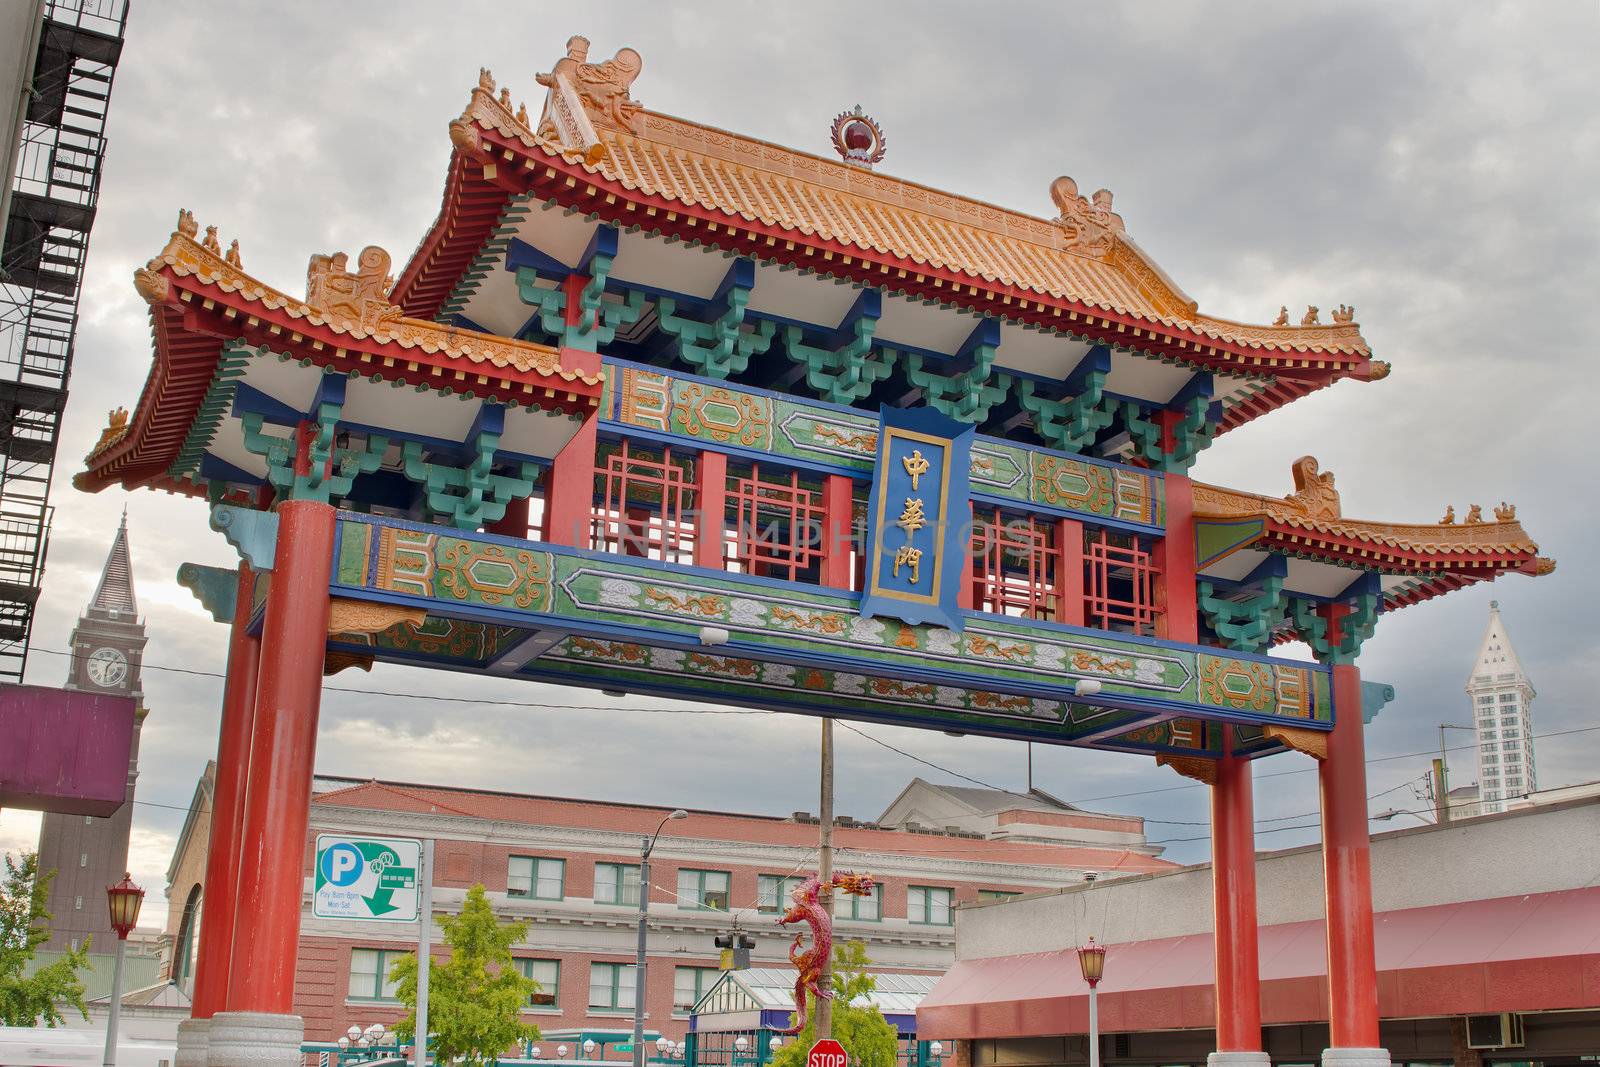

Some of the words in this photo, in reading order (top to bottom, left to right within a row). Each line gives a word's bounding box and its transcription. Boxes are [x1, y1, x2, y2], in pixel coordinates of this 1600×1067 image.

[893, 449, 930, 585] 中華門
[331, 848, 357, 882] P
[811, 1053, 845, 1067] STOP
